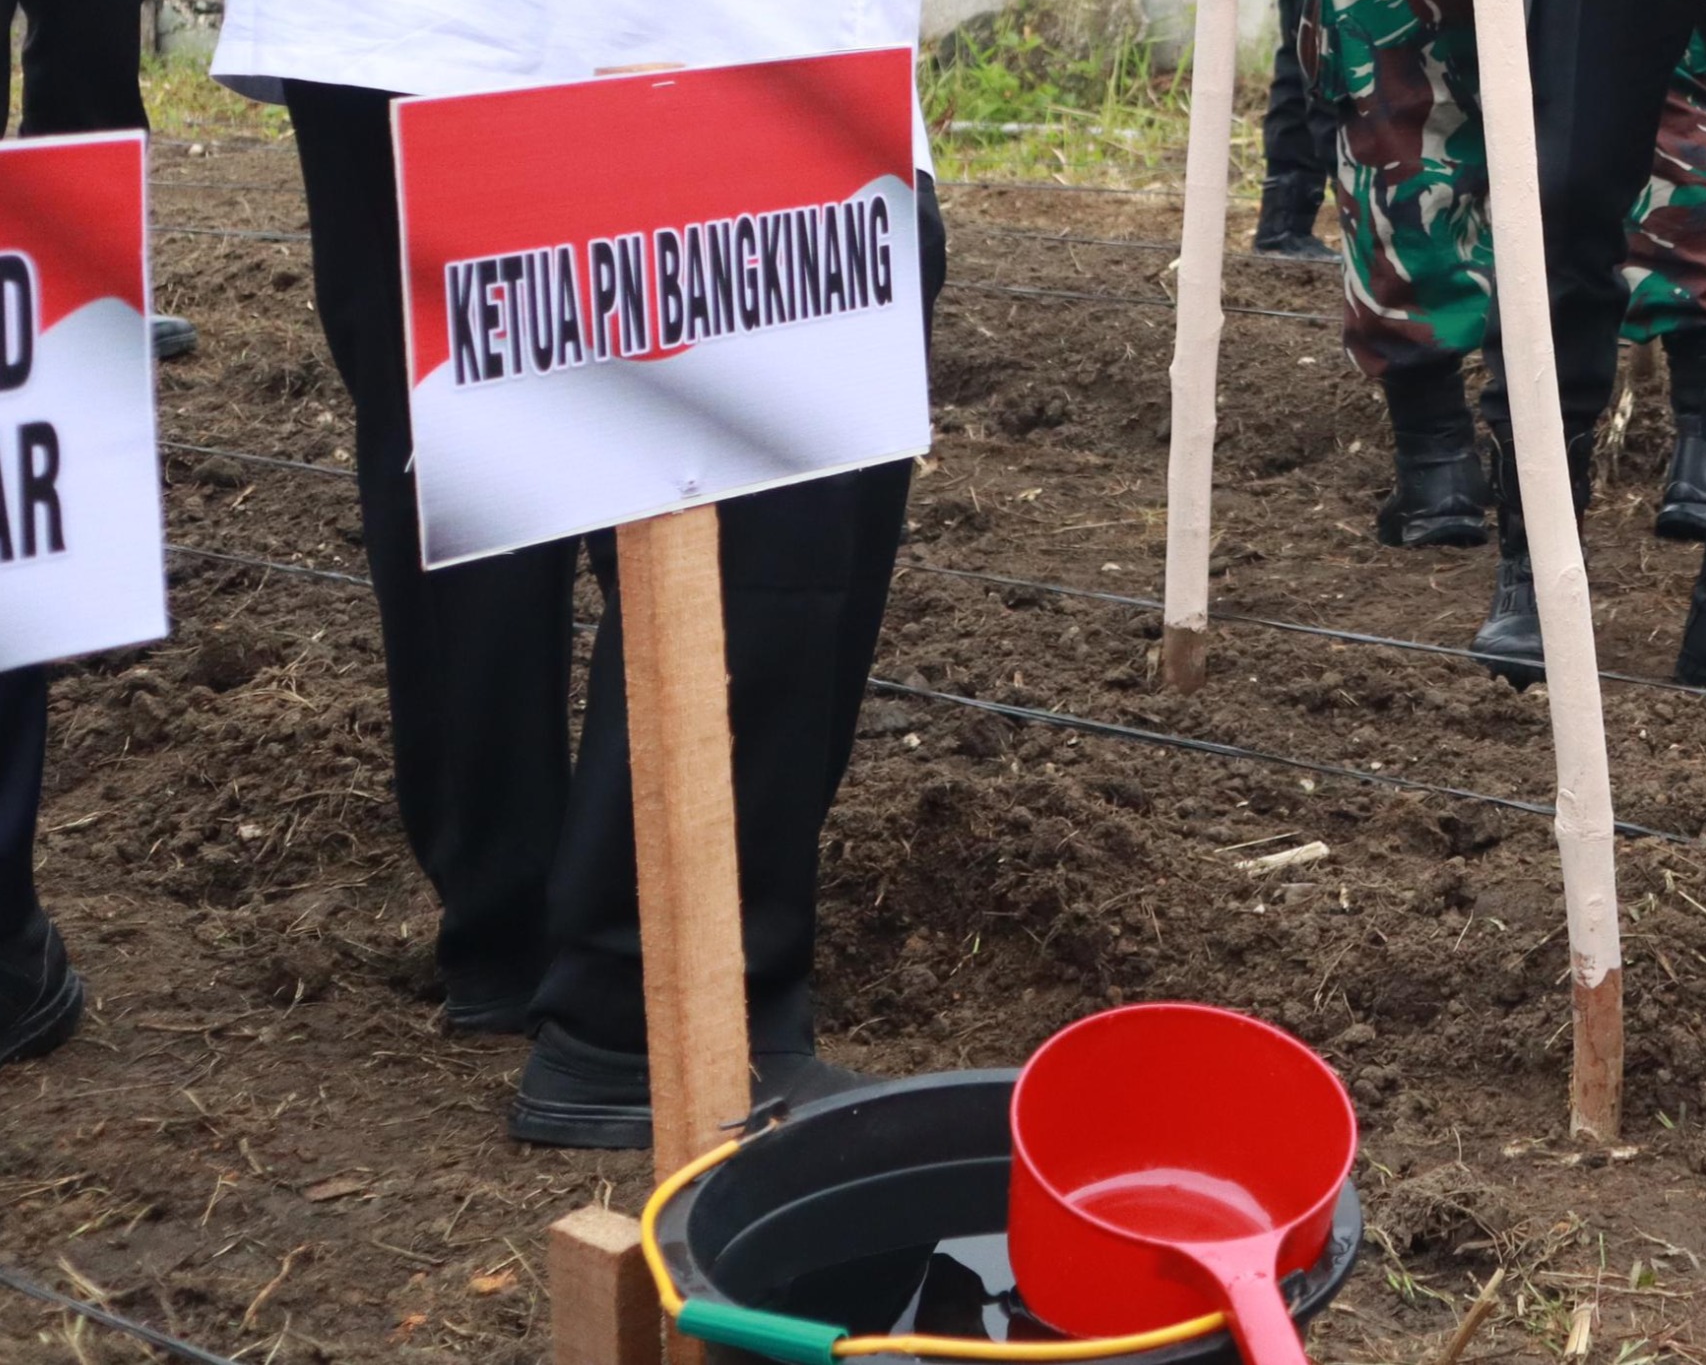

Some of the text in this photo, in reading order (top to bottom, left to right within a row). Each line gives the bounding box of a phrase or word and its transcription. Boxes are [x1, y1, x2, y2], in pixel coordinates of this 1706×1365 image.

[447, 195, 894, 386] KETUA PN BANGKINANG
